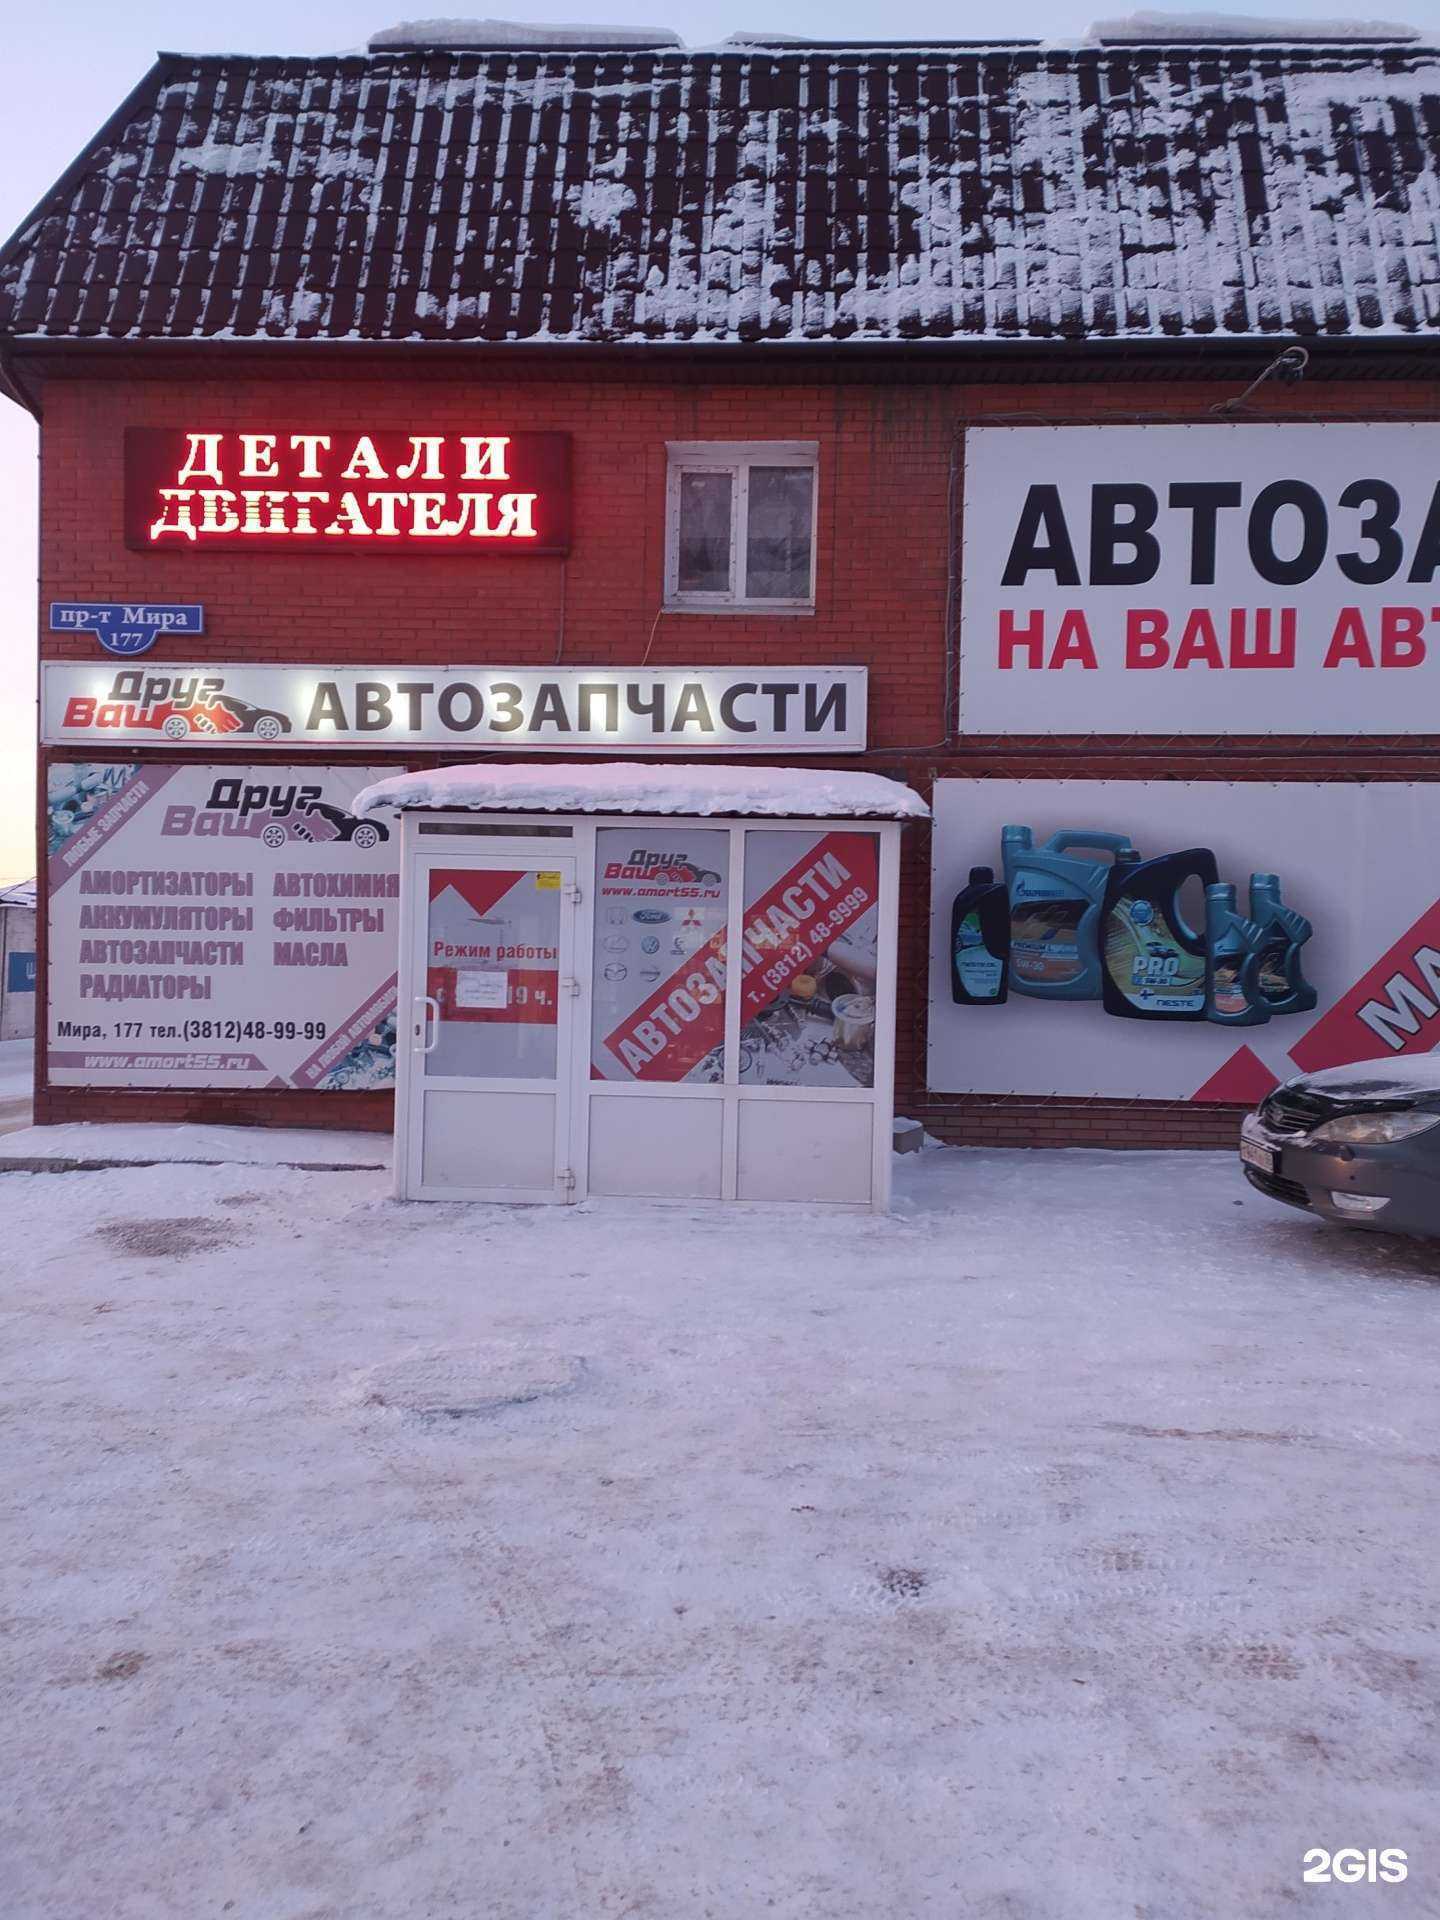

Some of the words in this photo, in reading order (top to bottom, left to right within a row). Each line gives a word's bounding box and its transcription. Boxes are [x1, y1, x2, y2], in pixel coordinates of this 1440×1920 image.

[178, 433, 511, 485] ДЕТАЛИ
[150, 489, 537, 541] ДВИГАТЕЛЯ
[60, 609, 112, 628] пр-т
[122, 607, 188, 630] Мира
[110, 633, 143, 647] 177
[998, 609, 1098, 669] НА
[1125, 608, 1297, 669] ВАШ
[1323, 607, 1440, 668] АВ
[108, 671, 224, 707] Друг
[62, 697, 157, 728] Ваш
[306, 682, 846, 733] АВТОЗАПЧАСТИ
[206, 779, 322, 816] Друг
[160, 805, 251, 837] Ваш
[79, 871, 253, 896] АМОРТИЗАТОРЫ
[273, 873, 400, 897] АВТОХИМИЯ
[79, 905, 253, 931] АККУМУЛЯТОРЫ
[273, 908, 384, 932] ФИЛЬТРЫ
[434, 941, 490, 957] Режим
[497, 945, 558, 961] работы
[762, 941, 813, 991] (3812)
[809, 886, 869, 944] 48-9999
[79, 940, 243, 965] АВТОЗАПЧАСТИ
[273, 942, 348, 966] МАСЛА
[1133, 956, 1179, 976] PRO
[79, 974, 211, 1001] РАДИАТОРЫ
[57, 1021, 106, 1040] Мира,
[113, 1023, 143, 1038] 177
